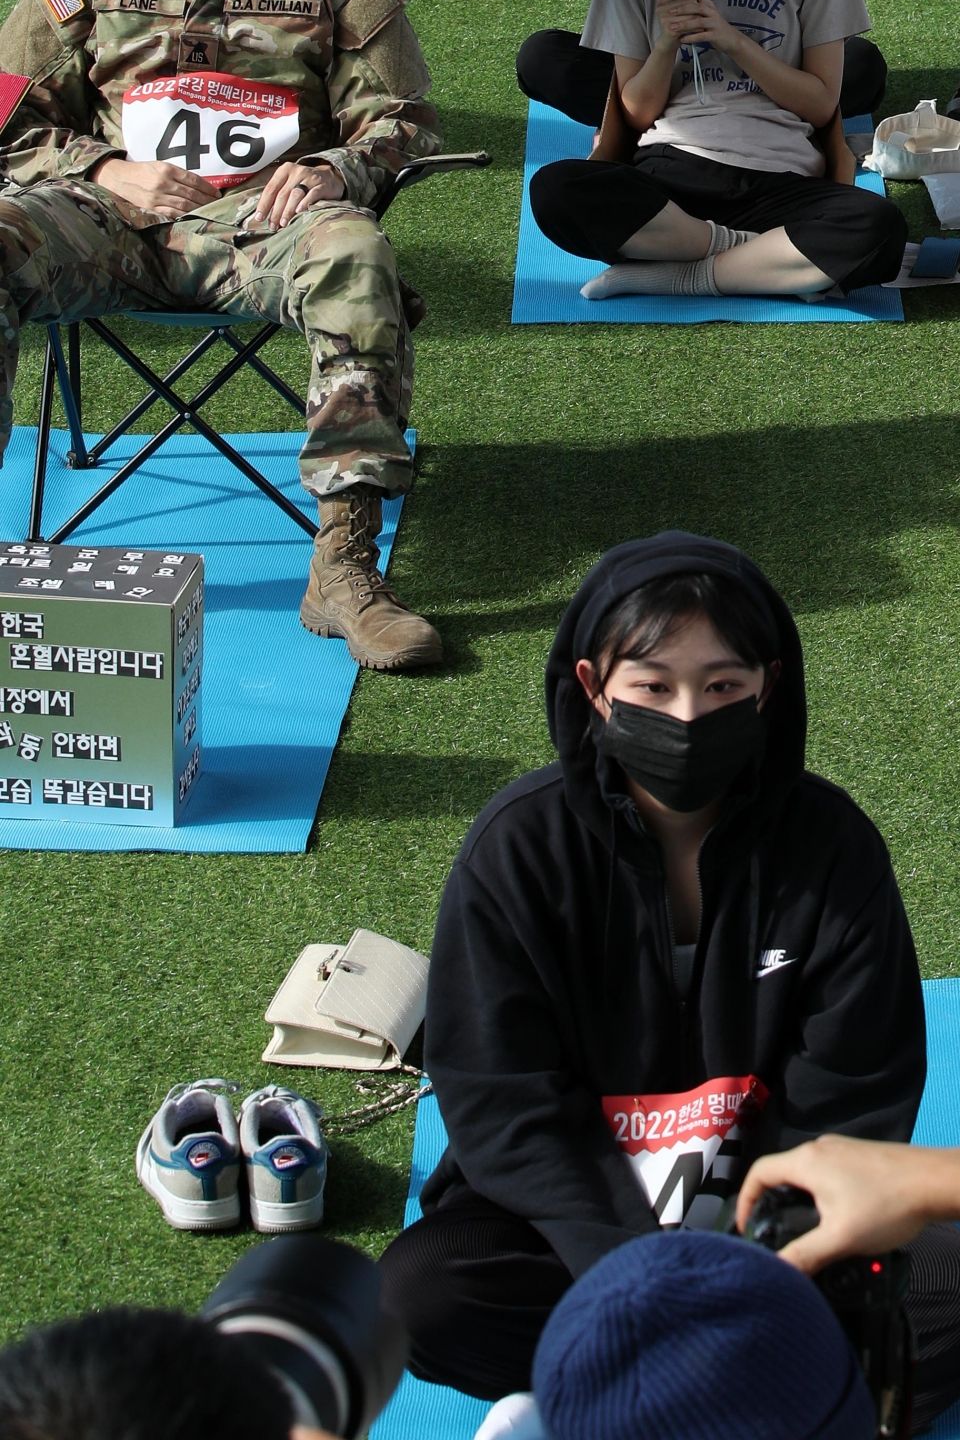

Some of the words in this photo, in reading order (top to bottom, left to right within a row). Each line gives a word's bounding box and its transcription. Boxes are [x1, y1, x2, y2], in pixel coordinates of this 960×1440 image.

[130, 79, 176, 97] 2022
[177, 77, 205, 92] 한강
[207, 80, 258, 104] 멍때리기
[261, 93, 286, 110] 대회
[155, 108, 266, 171] 46
[1, 612, 43, 638] 한국
[11, 643, 163, 679] 혼혈사람입니다
[53, 733, 119, 761] 안하면
[43, 779, 151, 810] 똑같습니다
[613, 1109, 678, 1142] 2022
[677, 1097, 704, 1125] 한강
